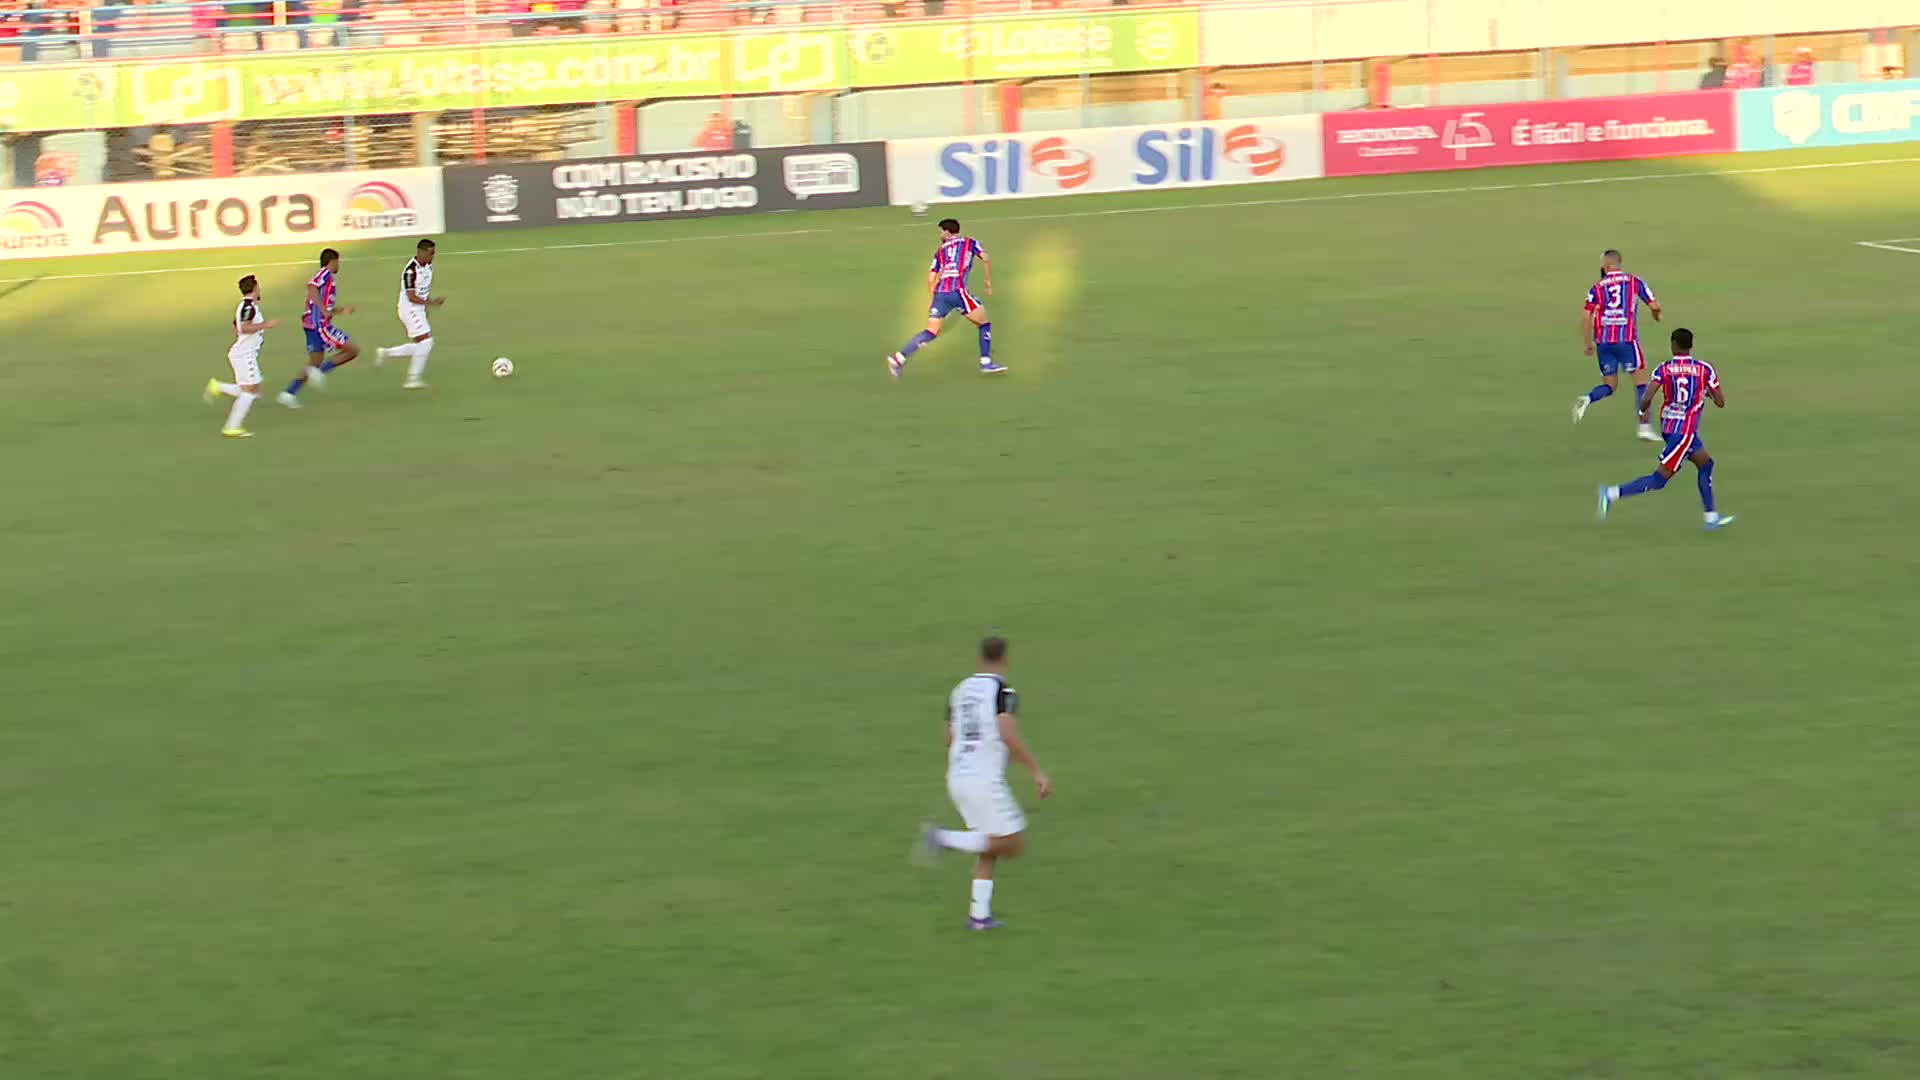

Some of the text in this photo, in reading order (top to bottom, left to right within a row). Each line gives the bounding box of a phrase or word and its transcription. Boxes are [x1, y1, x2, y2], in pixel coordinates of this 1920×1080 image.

[1532, 122, 1585, 144] fácil
[1586, 126, 1603, 141] e
[553, 154, 757, 189] COM RACISMO
[939, 139, 1022, 197] Sil
[1134, 127, 1215, 186] Sil
[93, 192, 317, 245] Aurora
[556, 185, 758, 218] NÃO TEM JOGO
[1608, 284, 1621, 308] 3
[1676, 377, 1689, 403] 6
